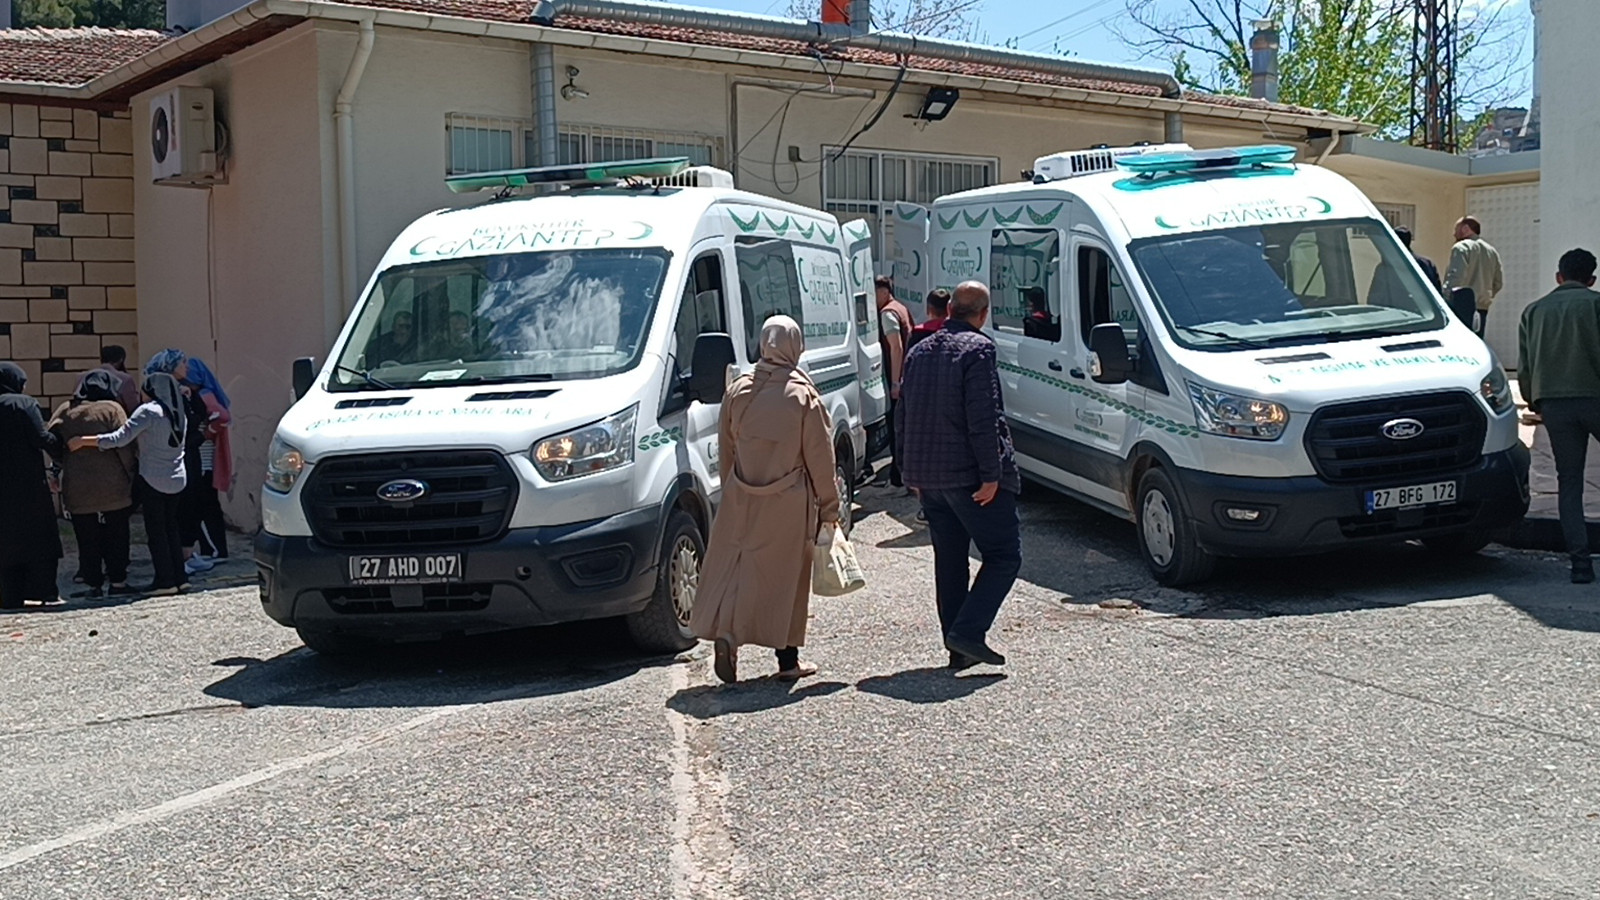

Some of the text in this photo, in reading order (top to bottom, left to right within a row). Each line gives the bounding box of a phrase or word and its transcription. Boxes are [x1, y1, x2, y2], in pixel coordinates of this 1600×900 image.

[1375, 482, 1455, 507] 27 BFG 172
[360, 555, 457, 578] 27 AHD 007
